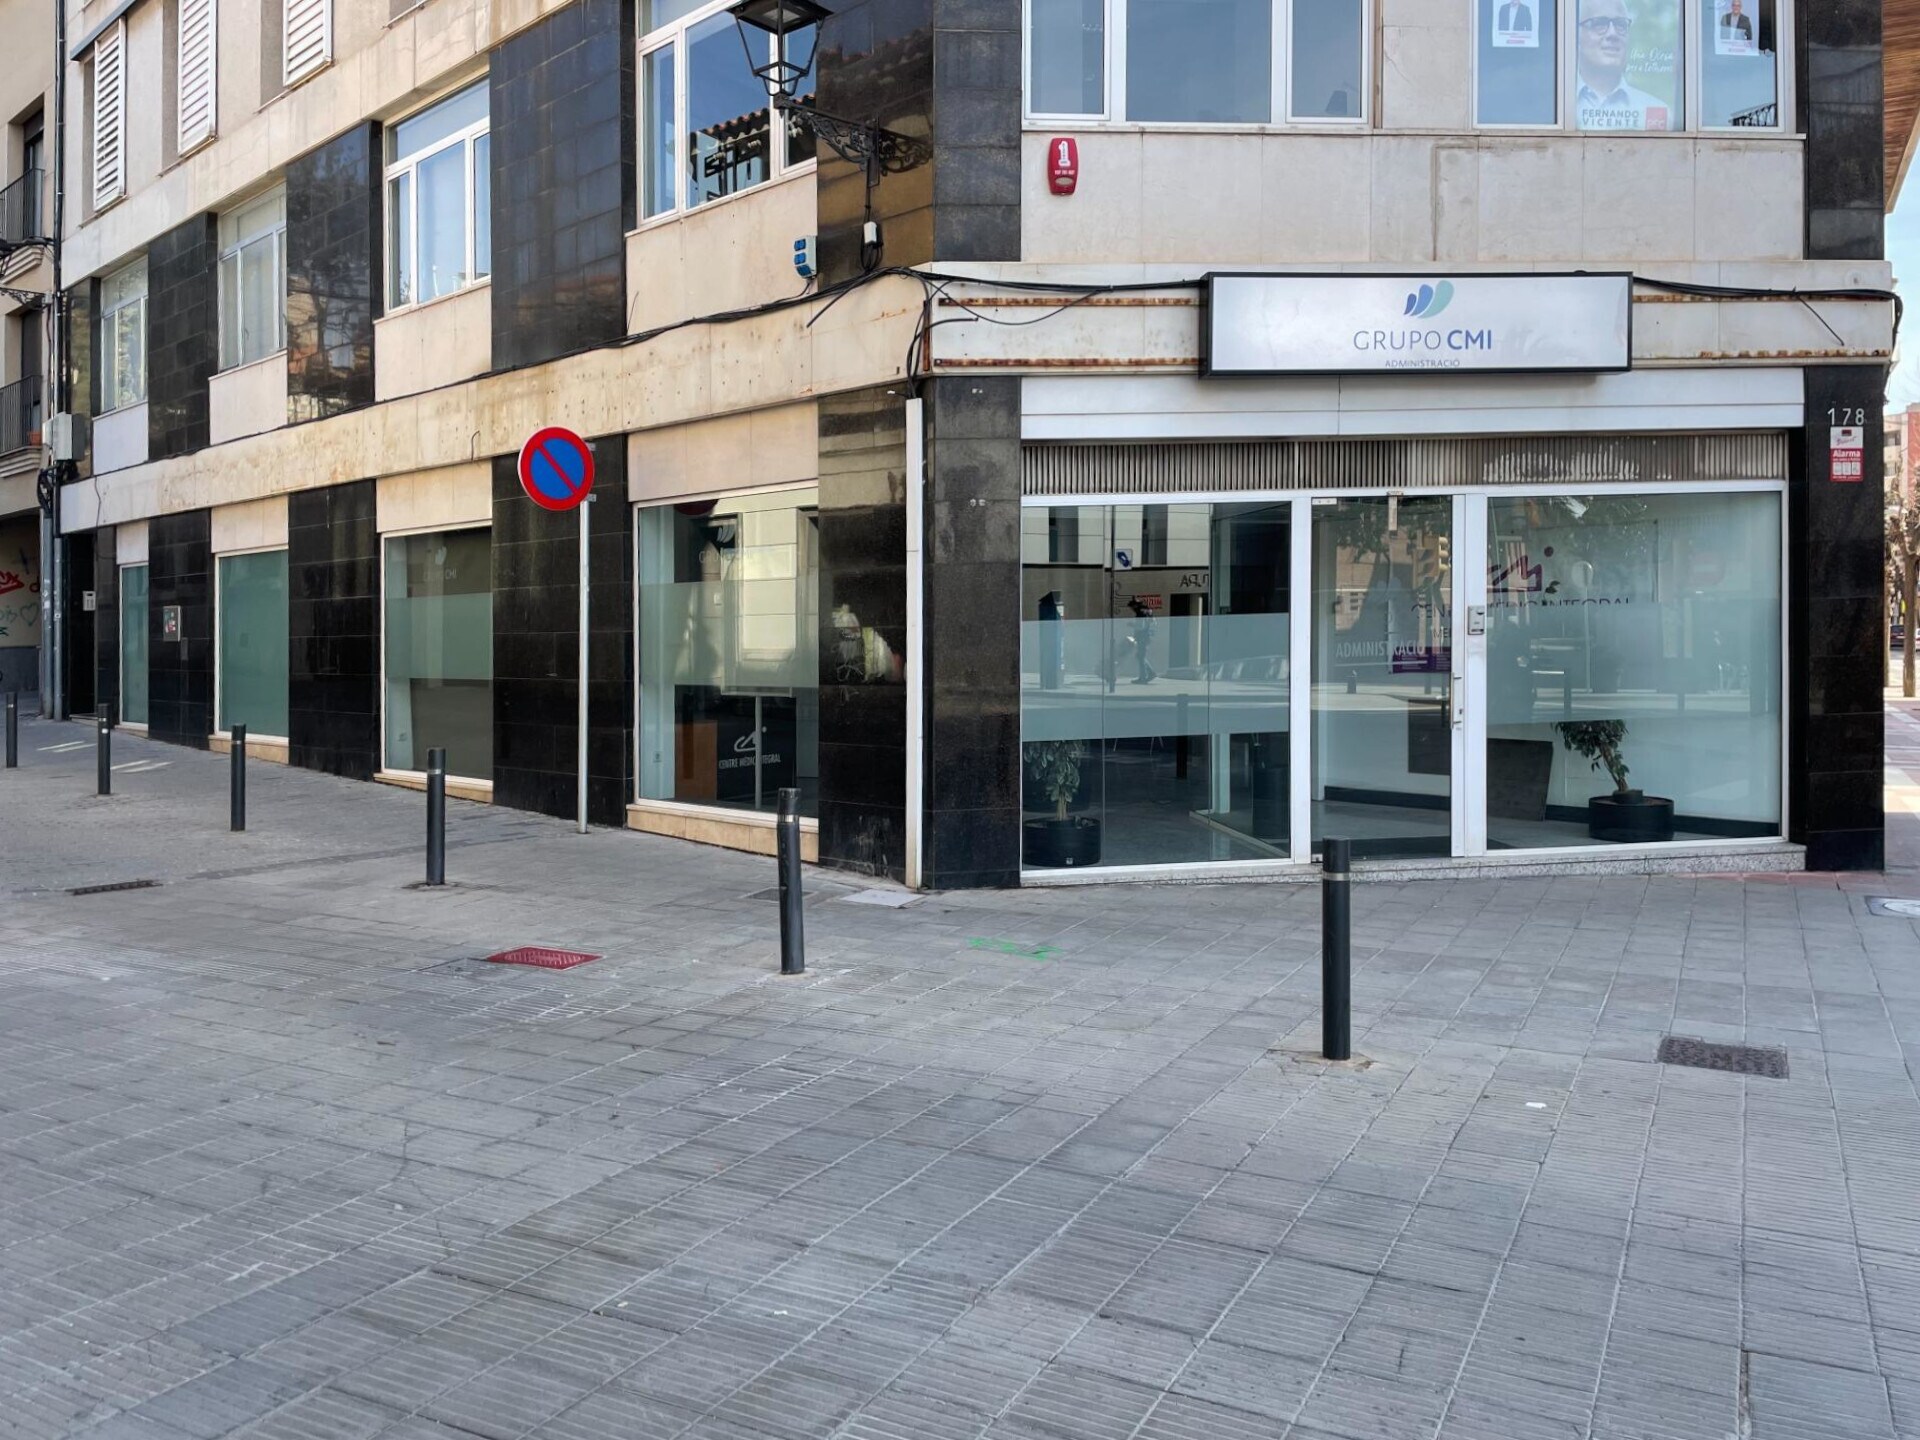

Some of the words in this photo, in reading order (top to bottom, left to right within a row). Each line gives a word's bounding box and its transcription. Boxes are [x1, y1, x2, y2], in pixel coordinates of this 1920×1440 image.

[1582, 109, 1640, 118] FERNANDO
[1582, 118, 1640, 127] VICENTE
[1353, 330, 1441, 351] GRUPO
[1447, 329, 1492, 350] CMI
[1385, 358, 1461, 367] ADMINISTRACIÓ
[1827, 407, 1865, 426] 178
[1832, 450, 1861, 458] Alarma
